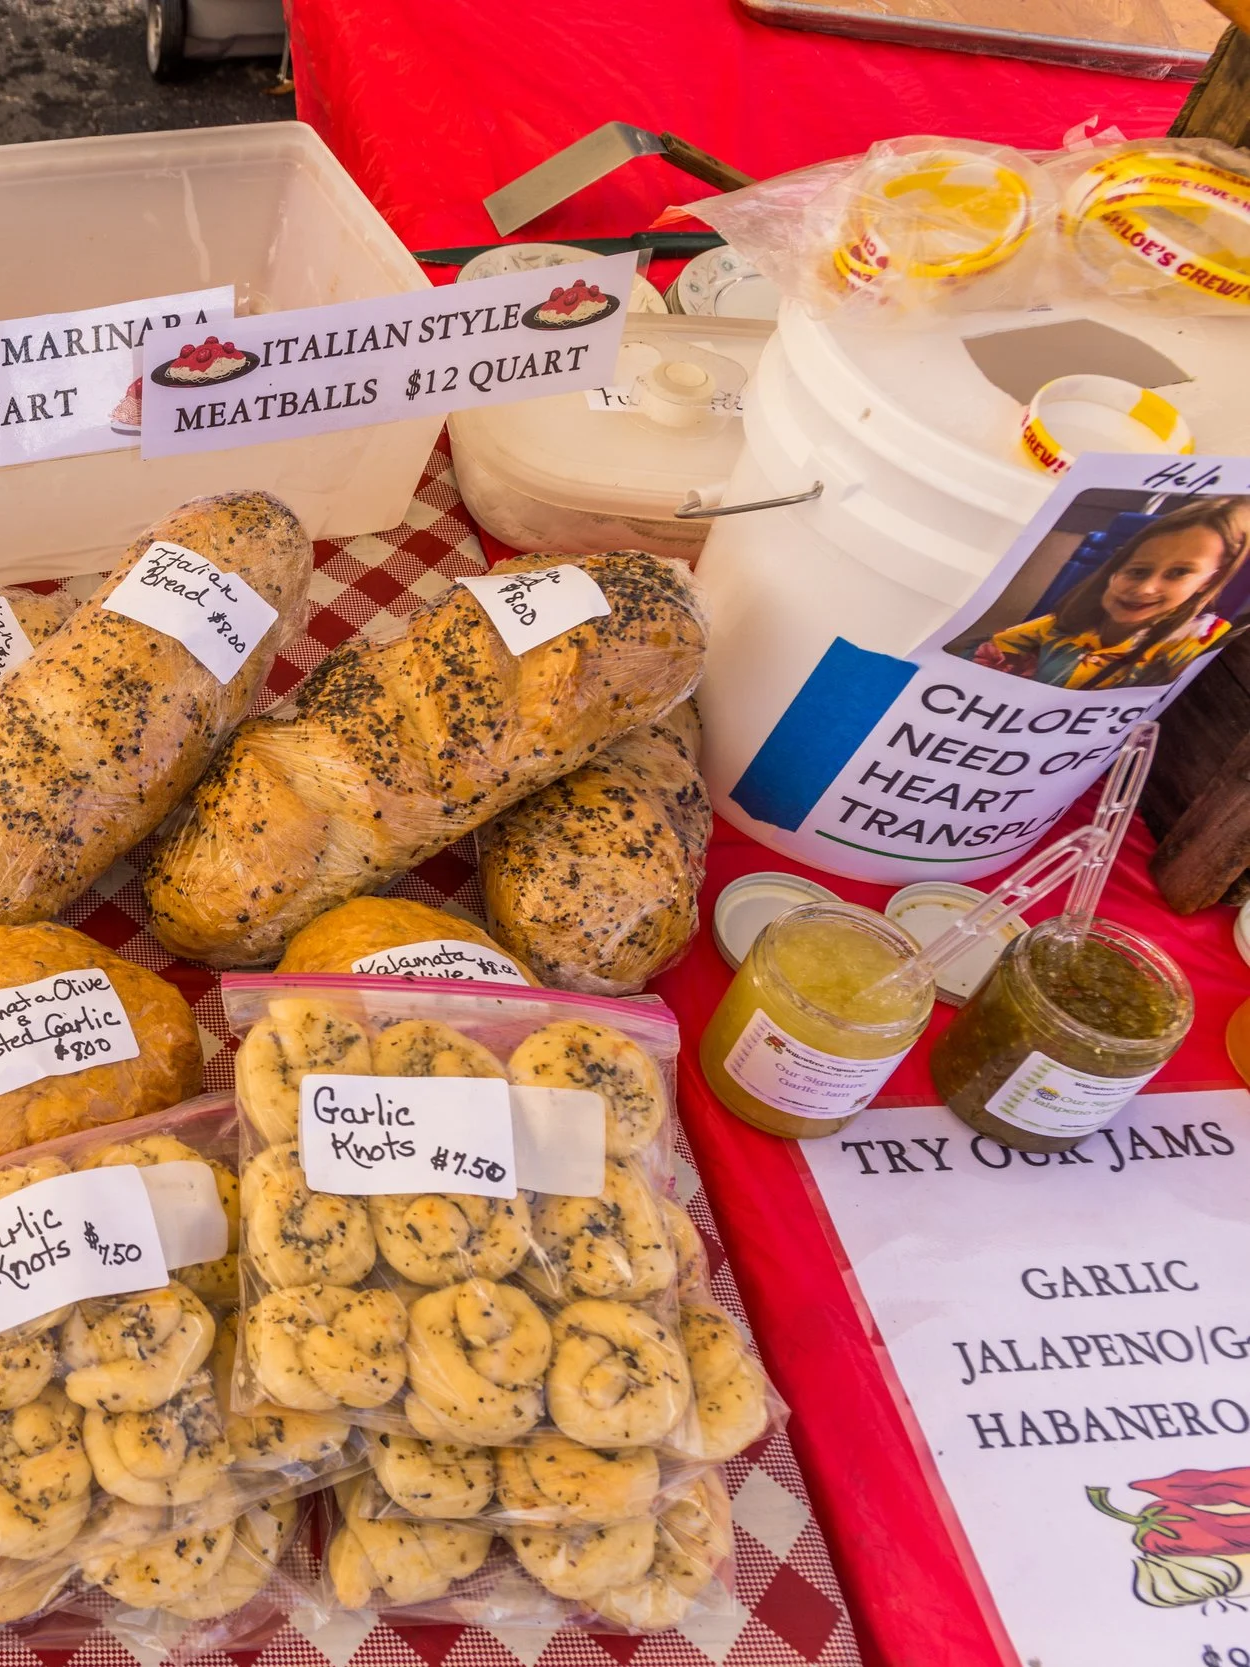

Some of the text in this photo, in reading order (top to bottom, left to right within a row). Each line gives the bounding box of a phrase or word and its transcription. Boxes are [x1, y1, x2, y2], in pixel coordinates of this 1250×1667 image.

[1194, 182, 1229, 200] LOVE
[1177, 262, 1248, 298] CREW!
[259, 302, 523, 368] ITALIAN STYLE
[174, 344, 590, 435] MEATBALLS $12 QUART
[1023, 426, 1067, 473] CREW!
[1143, 461, 1222, 496] Help
[149, 548, 238, 602] Italian
[140, 566, 246, 653] Bread $8.00
[497, 583, 537, 626] $8.00
[920, 683, 1146, 736] CHLOE'S
[887, 722, 1111, 776] NEED OF
[858, 761, 1034, 813] HEART
[356, 945, 476, 975] Kalamata
[53, 977, 110, 1000] Olive
[45, 1006, 121, 1038] Garlic
[54, 1038, 111, 1061] $8.00
[785, 1047, 825, 1067] Willowtree
[775, 1063, 801, 1078] Our
[803, 1075, 867, 1088] Signature
[778, 1078, 818, 1094] Garlic
[313, 1085, 415, 1126] Garlic
[1061, 1096, 1087, 1106] Our
[331, 1131, 506, 1183] Knots $7.50
[841, 1137, 953, 1175] TRY
[1098, 1121, 1236, 1172] JAMS
[84, 1220, 142, 1266] $7.50
[1020, 1260, 1200, 1300] GARLIC
[952, 1325, 1250, 1385] JALAPENO/G
[966, 1398, 1250, 1449] HABANERO
